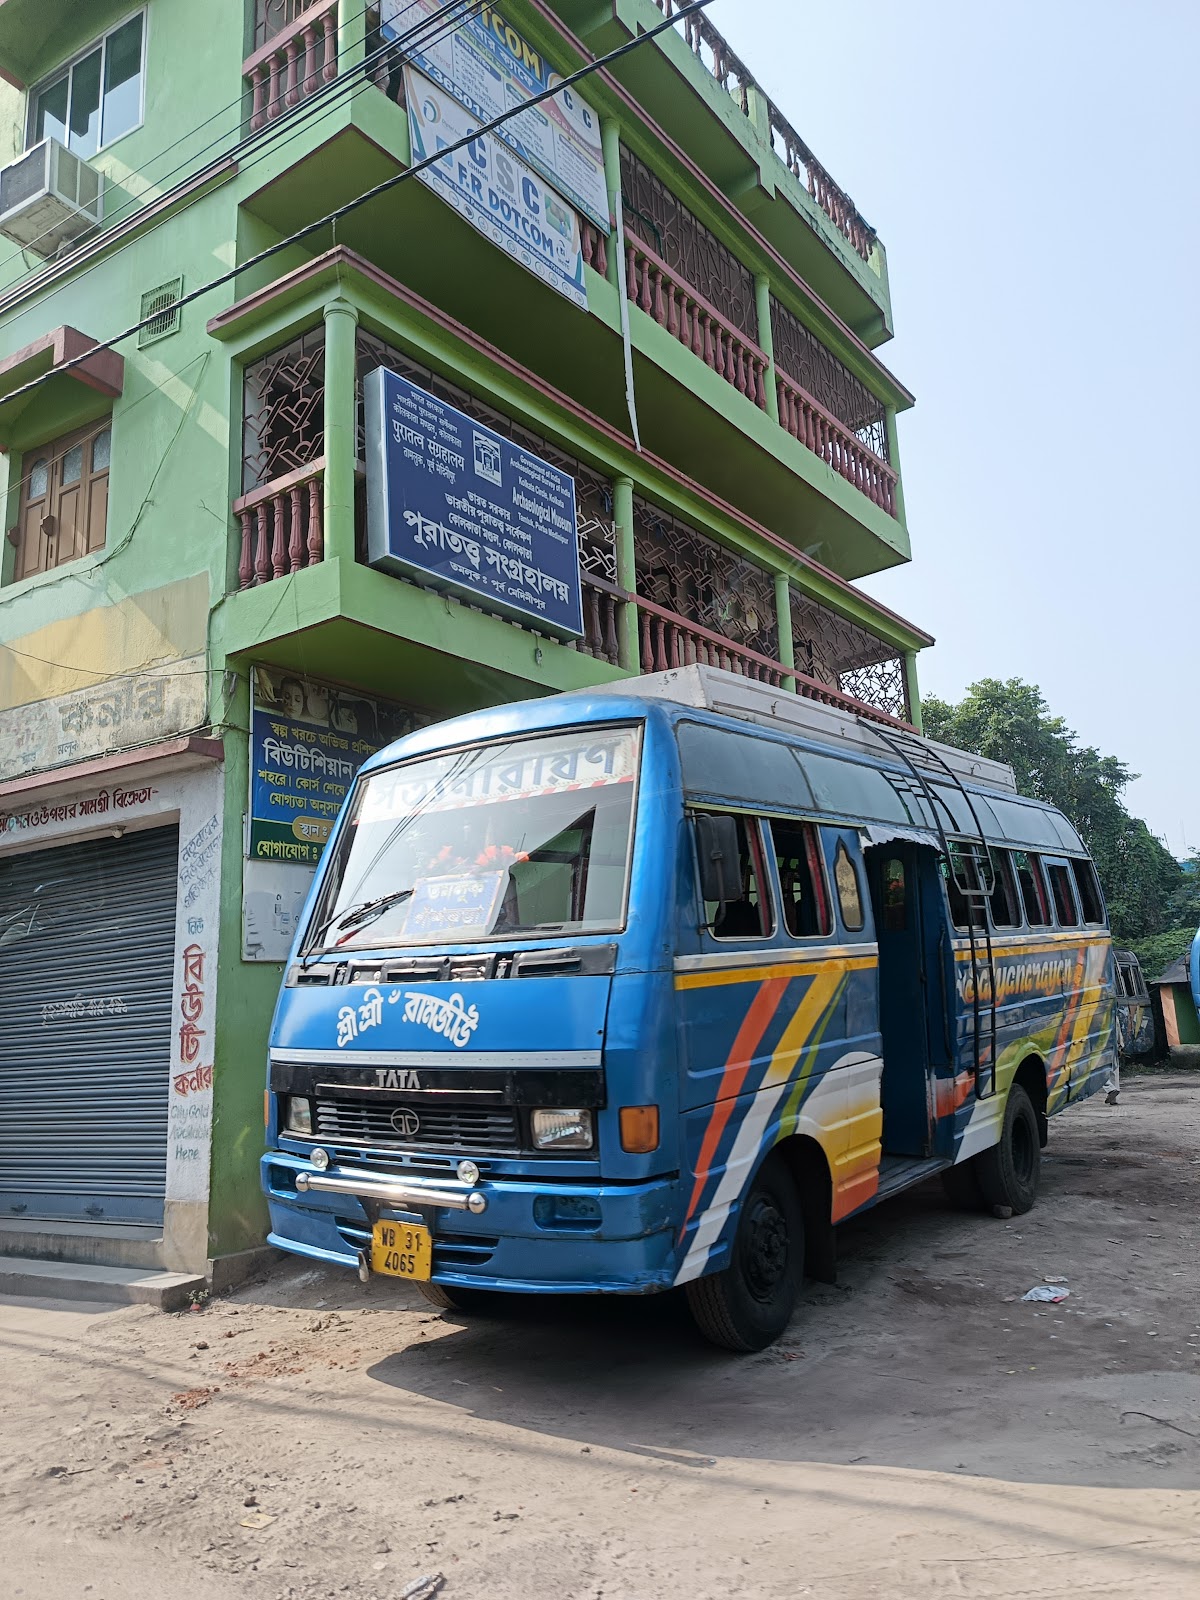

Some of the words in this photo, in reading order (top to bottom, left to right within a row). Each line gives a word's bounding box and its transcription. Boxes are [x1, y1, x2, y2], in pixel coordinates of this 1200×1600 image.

[467, 160, 489, 182] COMMON
[496, 184, 518, 206] SERVICES
[457, 161, 484, 202] F.R
[488, 187, 554, 258] DOTCOM
[396, 393, 417, 410] भारतीय
[410, 390, 424, 404] भारत
[425, 399, 444, 415] सरकार
[391, 418, 424, 449] पुरातत्व
[392, 401, 418, 423] कोलकाता
[438, 427, 461, 448] कोलकाता
[510, 457, 540, 481] Archaeological
[540, 475, 555, 490] Survey
[560, 485, 570, 497] India
[519, 454, 545, 475] Government
[550, 472, 560, 484] India
[444, 492, 476, 517] ভারতীয়
[466, 490, 486, 508] ভারত
[487, 501, 510, 521] সরকার
[518, 475, 534, 492] Kolkata
[548, 492, 564, 508] Kolkata
[512, 486, 550, 523] Archaeological
[550, 507, 572, 533] Museum
[448, 512, 481, 537] কোলকাতা
[502, 538, 532, 561] কোলকাতা
[402, 510, 481, 570] পুরাতত্ত্ব
[482, 545, 569, 604] সংগ্রহালয়
[490, 579, 506, 593] পূর্ব
[270, 721, 289, 740] স্বল্প
[291, 727, 318, 744] খরচে
[319, 731, 350, 751] অভিজ্ঞ
[351, 739, 381, 755] প্রশিক্ষ
[262, 737, 354, 780] বিউটিশিয়ান
[296, 775, 322, 793] কোর্স
[323, 782, 346, 797] শেষে
[79, 789, 111, 817] সামগ্রী
[269, 792, 308, 810] যোগ্যতা
[309, 798, 343, 817] অনুসা
[298, 822, 320, 839] স্থান
[257, 839, 310, 860] যোগাযোগ
[186, 916, 204, 935] নিউ
[375, 1069, 421, 1090] TATA
[175, 1143, 200, 1161] Here
[384, 1250, 416, 1274] 4065
